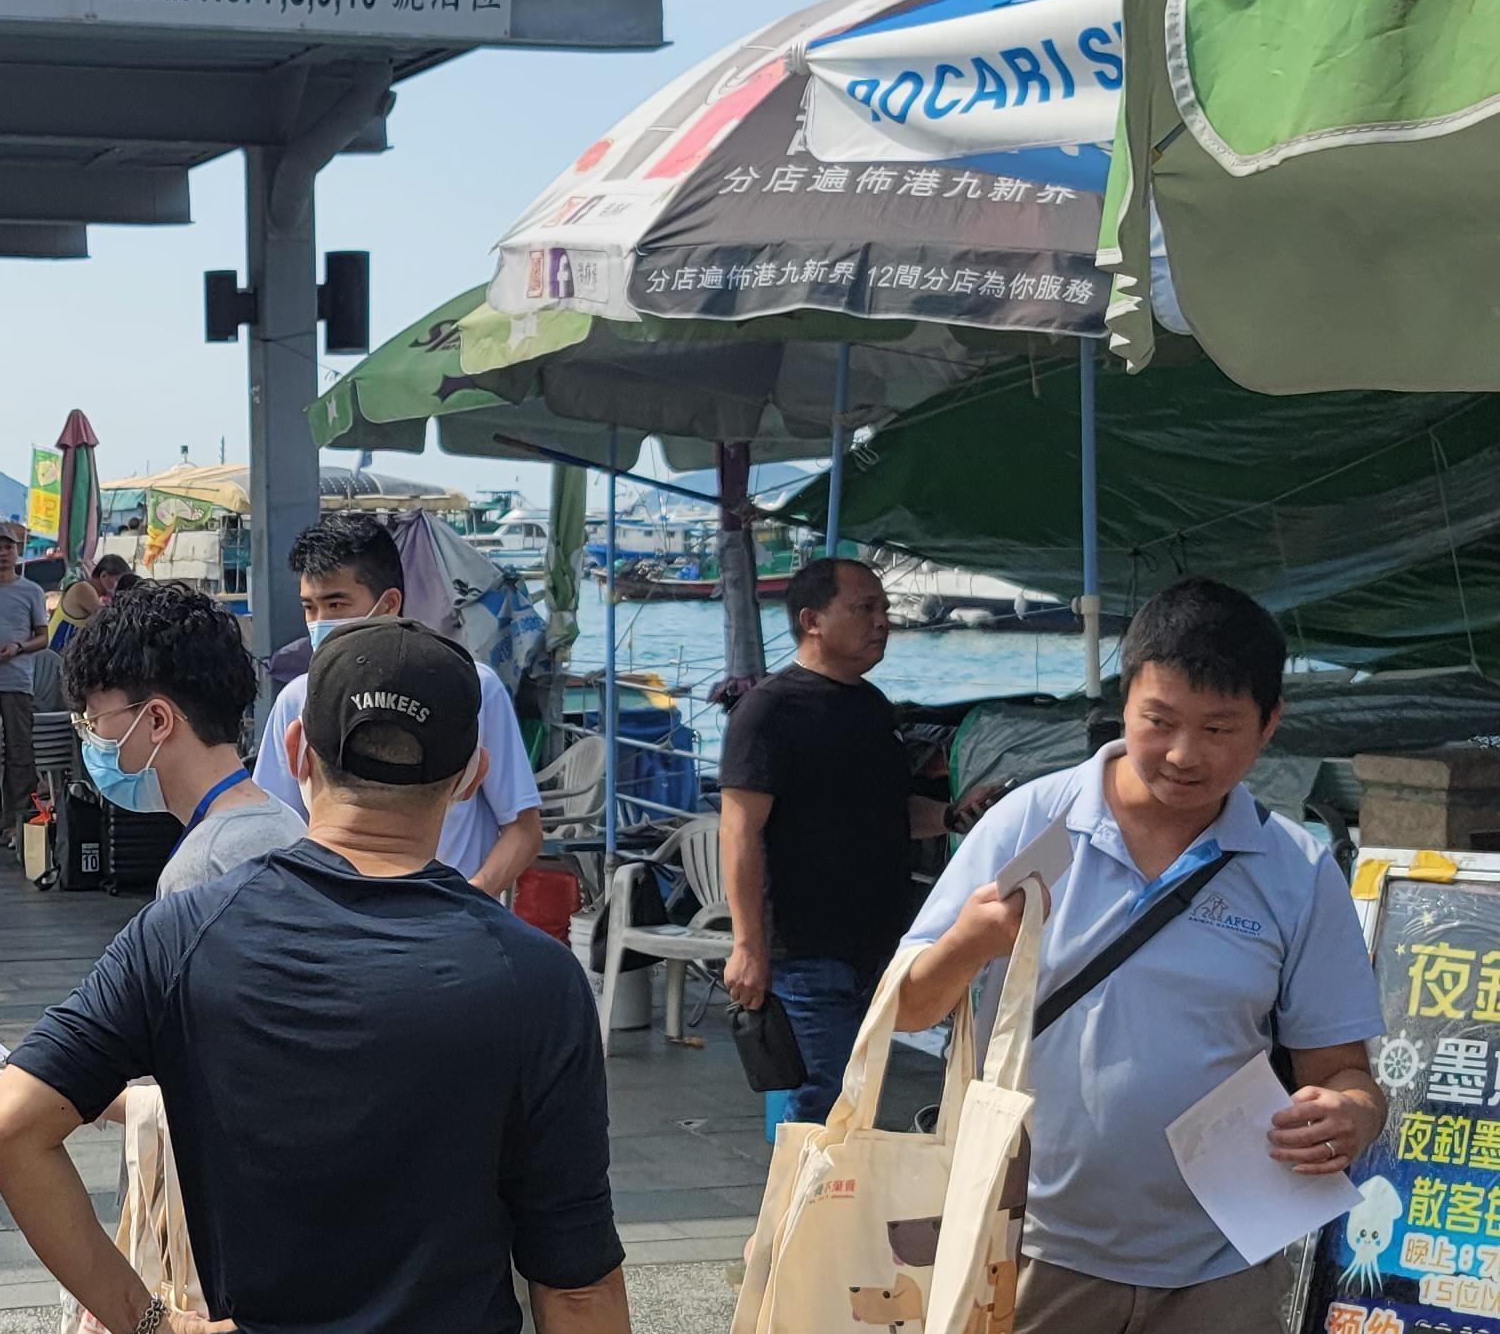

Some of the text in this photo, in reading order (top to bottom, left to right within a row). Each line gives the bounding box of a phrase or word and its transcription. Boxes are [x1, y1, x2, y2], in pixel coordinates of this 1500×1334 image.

[645, 258, 1096, 305] 分店遍佈港九新界 12間分店為你服務
[350, 691, 430, 723] YANKEES
[1224, 914, 1262, 932] AFCD
